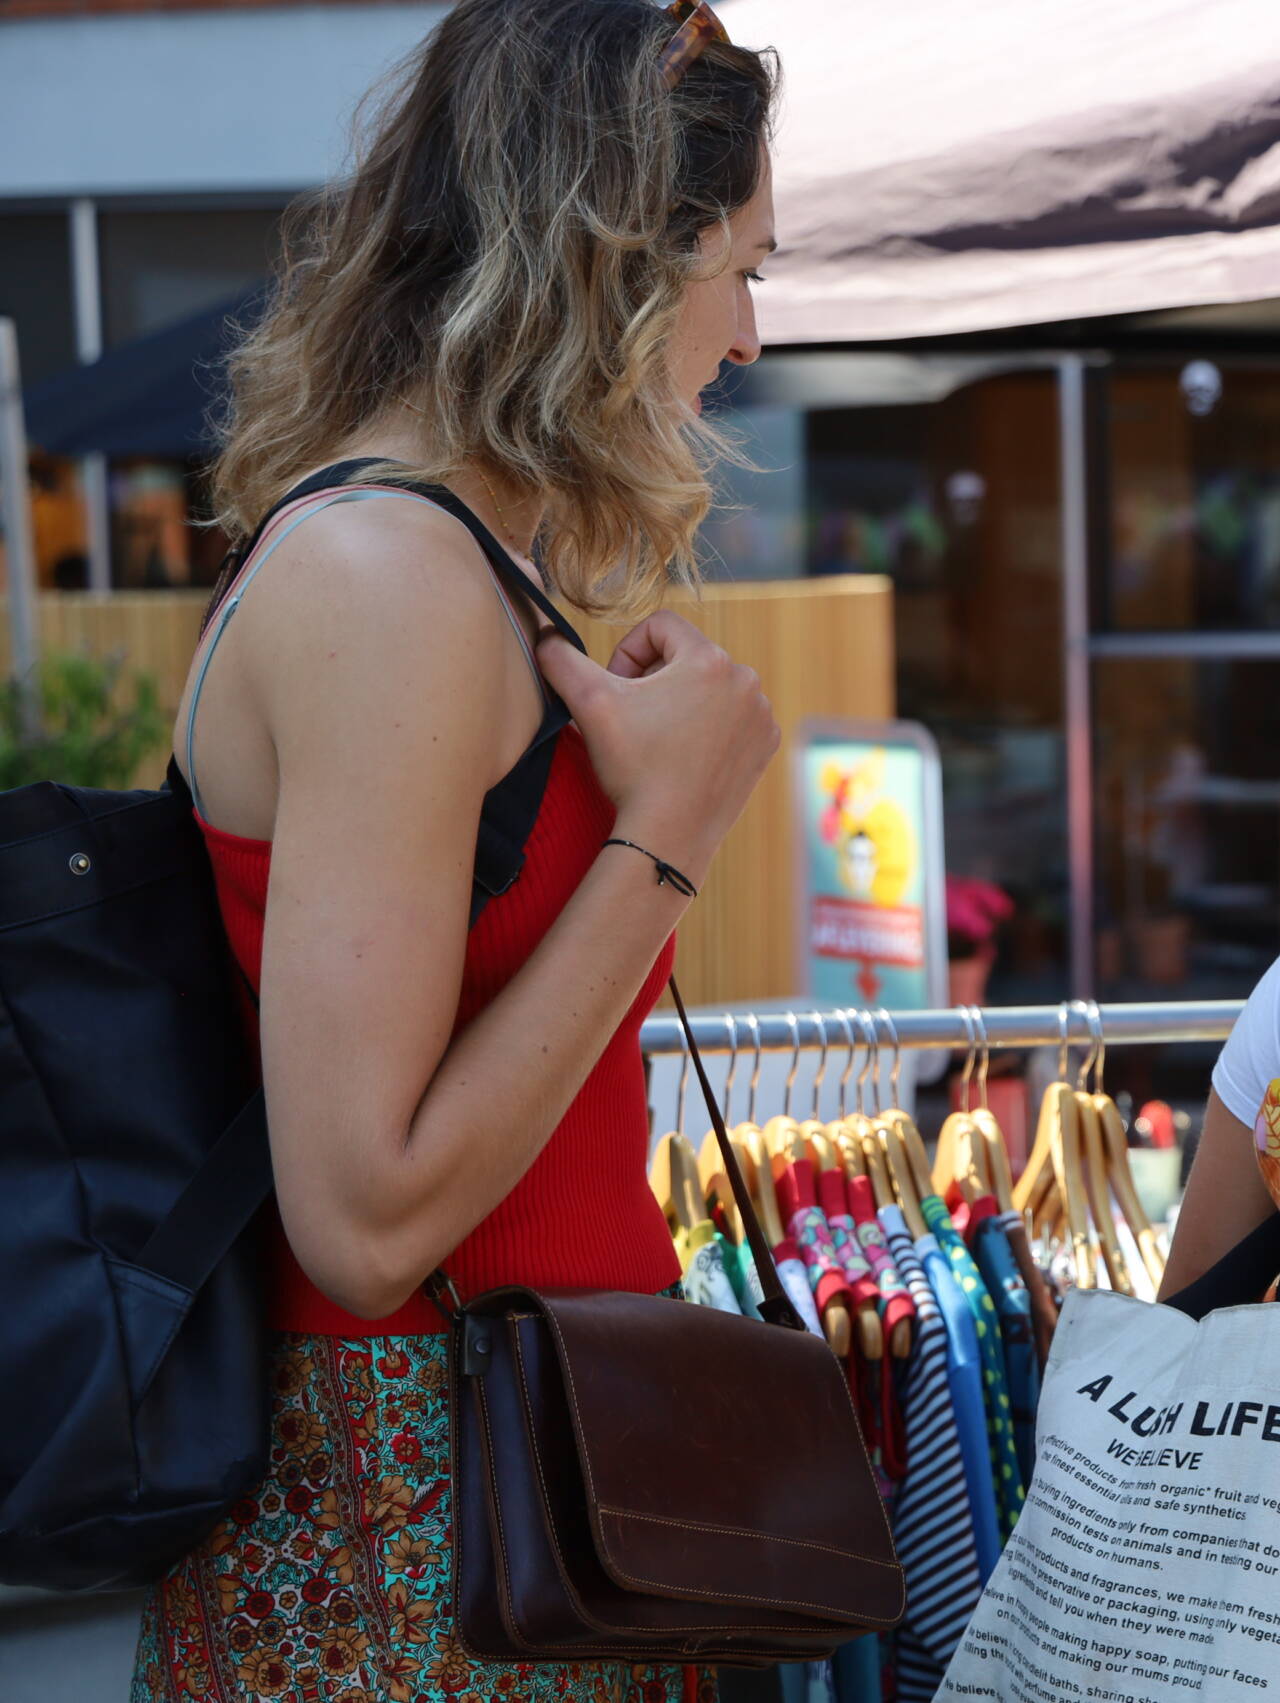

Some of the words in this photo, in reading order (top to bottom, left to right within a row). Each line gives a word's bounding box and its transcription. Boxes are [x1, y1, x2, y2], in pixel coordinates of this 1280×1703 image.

[1076, 1374, 1114, 1402] A
[1108, 1391, 1184, 1438] LUSH
[1073, 1451, 1118, 1484] products
[1214, 1487, 1242, 1502] fruit
[1106, 1438, 1139, 1466] WE
[1050, 1454, 1076, 1476] finest
[1074, 1470, 1121, 1502] essential
[1154, 1499, 1180, 1511] safe
[1051, 1527, 1094, 1554] products
[1096, 1548, 1110, 1560] on
[1110, 1552, 1164, 1572] humans.
[1061, 1492, 1118, 1529] ingredients
[1140, 1522, 1169, 1536] from
[1172, 1529, 1237, 1549] companies
[1239, 1538, 1260, 1552] that
[1263, 1545, 1280, 1558] do
[1083, 1525, 1110, 1542] tests
[1110, 1536, 1122, 1545] on
[1123, 1538, 1173, 1554] animals
[1176, 1547, 1202, 1560] and
[1205, 1550, 1218, 1562] in
[1256, 1562, 1278, 1576] our
[1035, 1548, 1070, 1574] products
[1070, 1568, 1090, 1582] and
[1090, 1574, 1161, 1600] fragrances,
[1166, 1592, 1185, 1603] we
[1188, 1596, 1218, 1610] make
[1037, 1568, 1091, 1601] preservative
[1092, 1593, 1105, 1605] or
[1107, 1598, 1180, 1622] packaging,
[1184, 1613, 1215, 1630] using
[1006, 1592, 1014, 1605] in
[1051, 1628, 1088, 1650] making
[1090, 1640, 1132, 1660] happy
[1135, 1650, 1170, 1666] soap,
[1173, 1658, 1208, 1676] putting
[1208, 1666, 1230, 1678] our
[1232, 1669, 1268, 1688] faces
[1036, 1586, 1048, 1600] and
[1050, 1594, 1064, 1608] tell
[1064, 1603, 1084, 1618] you
[1086, 1610, 1117, 1627] when
[1121, 1618, 1152, 1634] they
[1156, 1624, 1186, 1639] were
[976, 1630, 1008, 1648] believe
[1050, 1675, 1083, 1695] baths,
[1086, 1686, 1134, 1703] sharing
[996, 1609, 1010, 1620] on
[1041, 1641, 1058, 1656] and
[1058, 1650, 1102, 1672] making
[1105, 1662, 1128, 1674] our
[1132, 1667, 1170, 1683] mums
[956, 1682, 996, 1697] believe
[990, 1648, 1004, 1662] the
[1024, 1680, 1056, 1703] perfume
